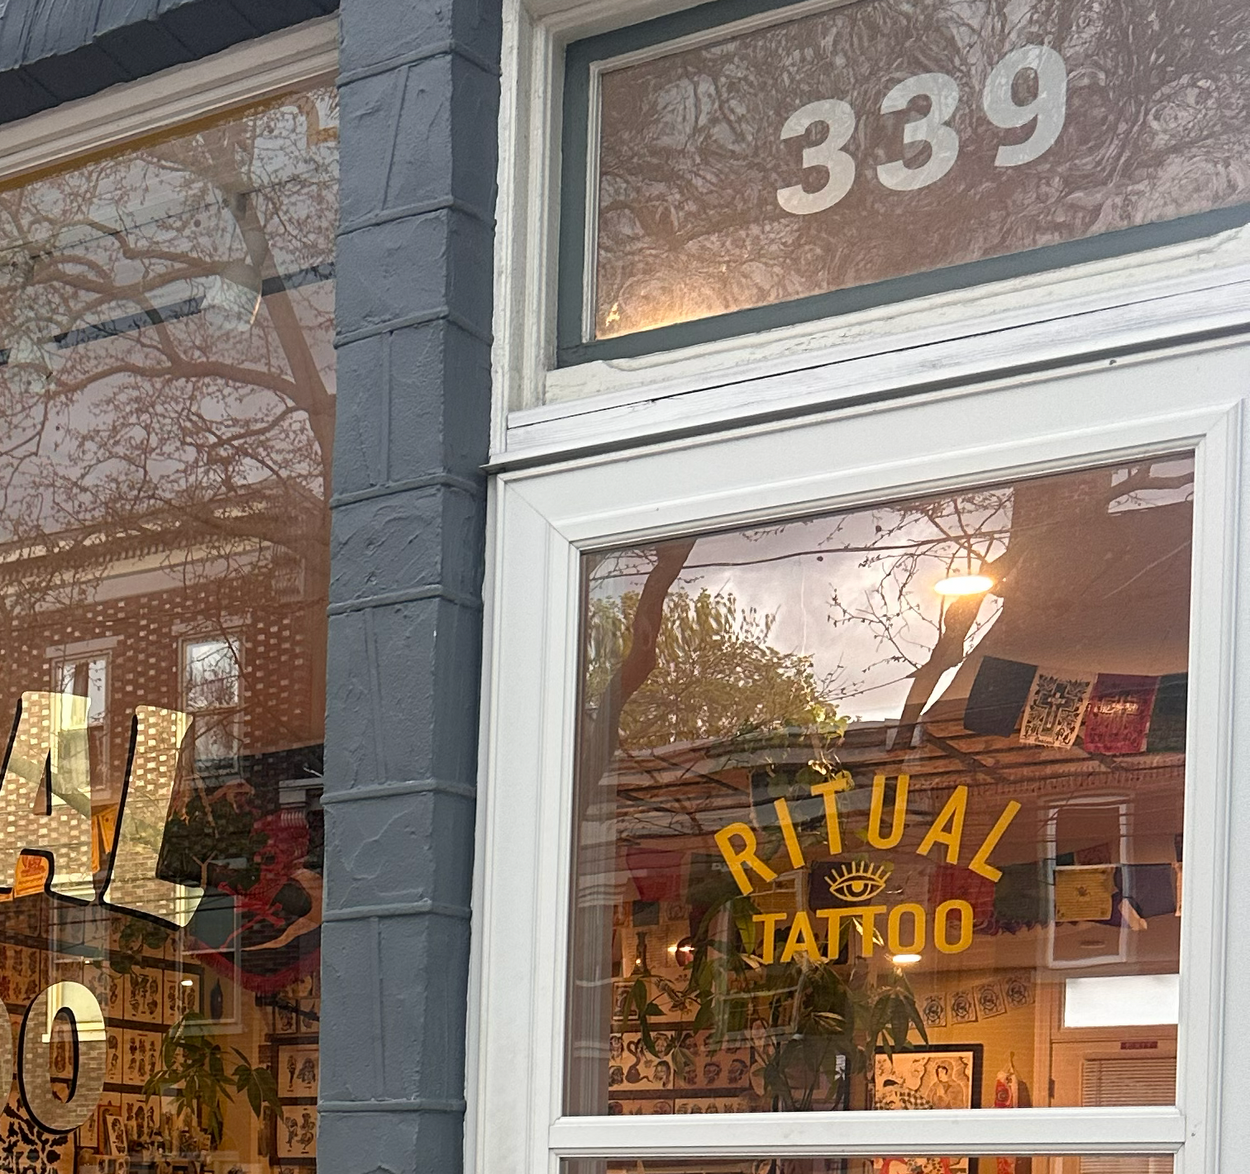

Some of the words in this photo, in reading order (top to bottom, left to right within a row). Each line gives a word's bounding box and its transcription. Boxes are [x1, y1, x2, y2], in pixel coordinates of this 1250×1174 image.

[776, 45, 1067, 215] 339
[713, 774, 1022, 896] RITUAL
[753, 900, 974, 964] TATTOO
